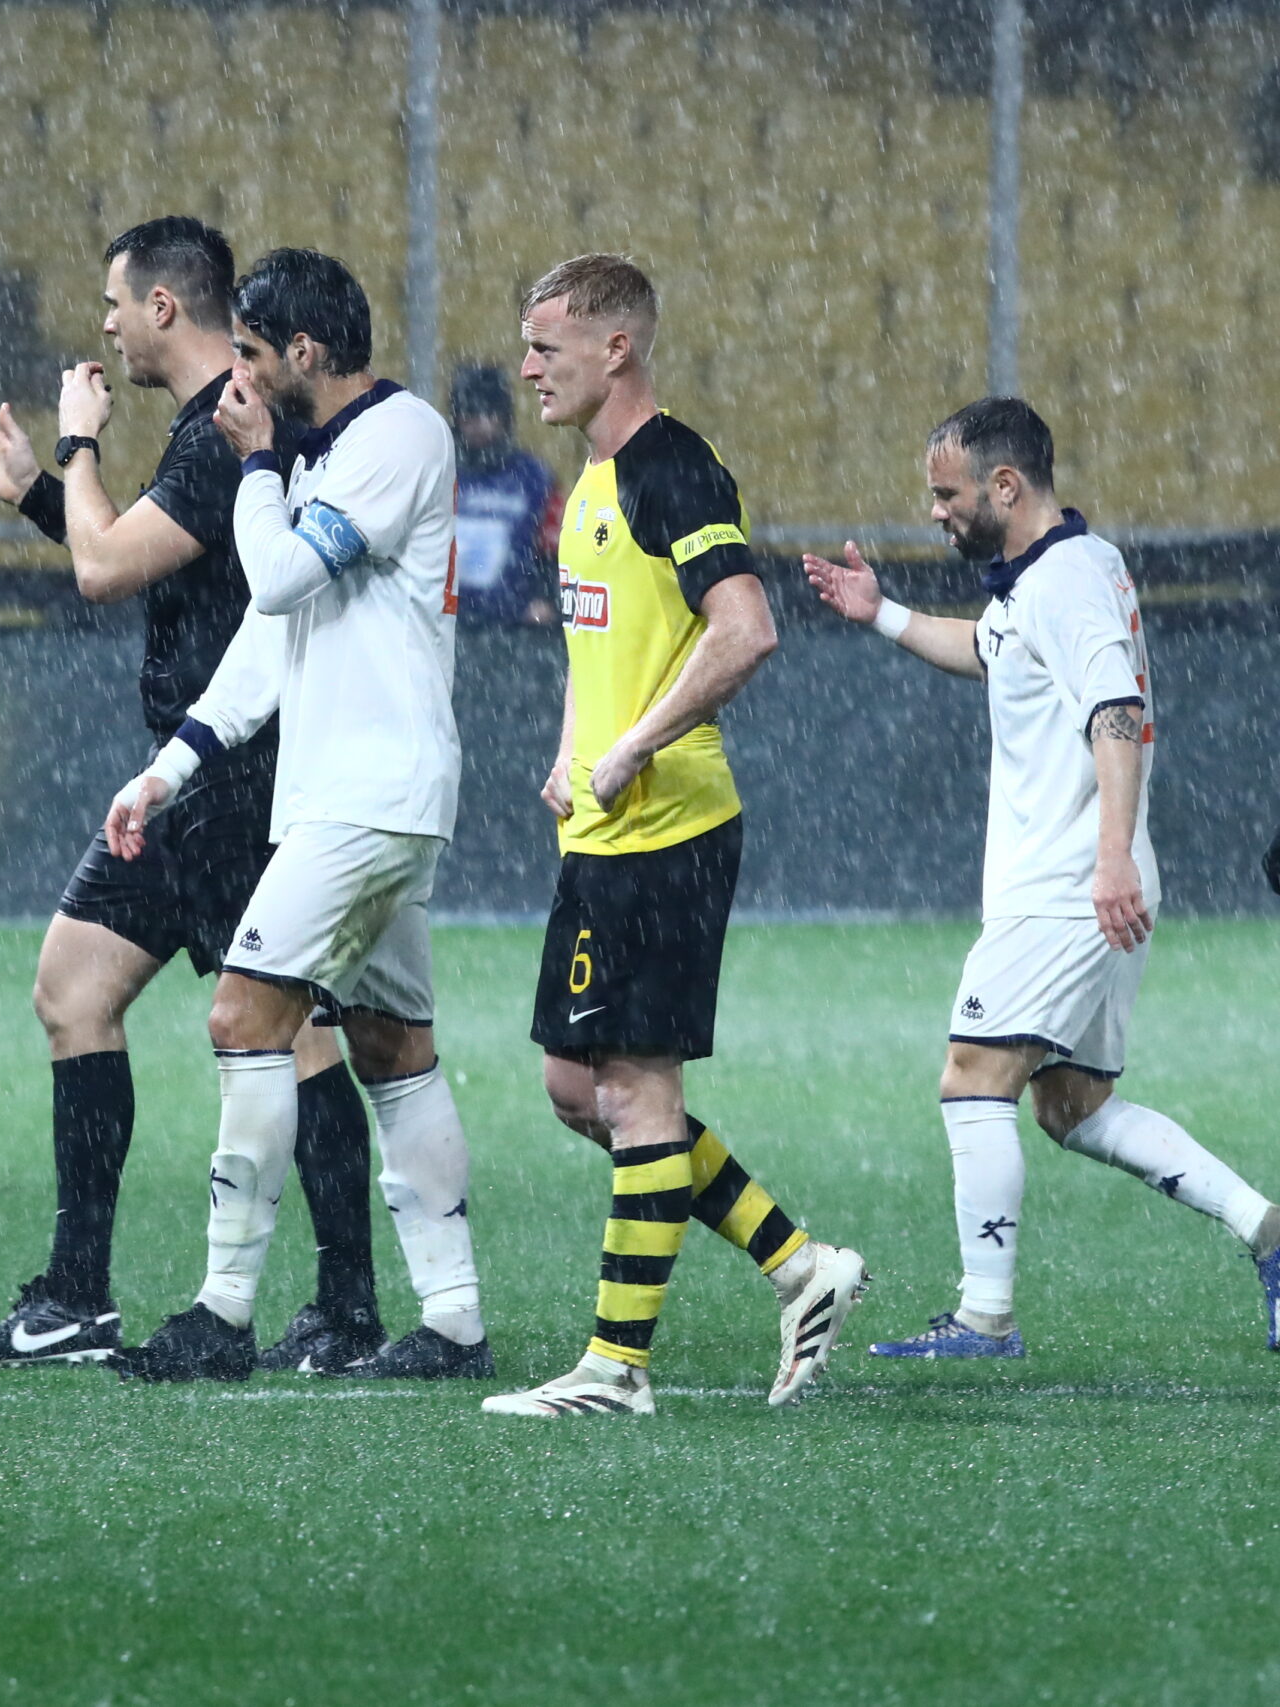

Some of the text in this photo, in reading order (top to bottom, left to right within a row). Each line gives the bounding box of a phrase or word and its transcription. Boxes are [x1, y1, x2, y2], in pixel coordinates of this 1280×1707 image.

[697, 530, 738, 547] Piraeus
[569, 929, 591, 994] 6
[960, 1008, 984, 1020] Kappa
